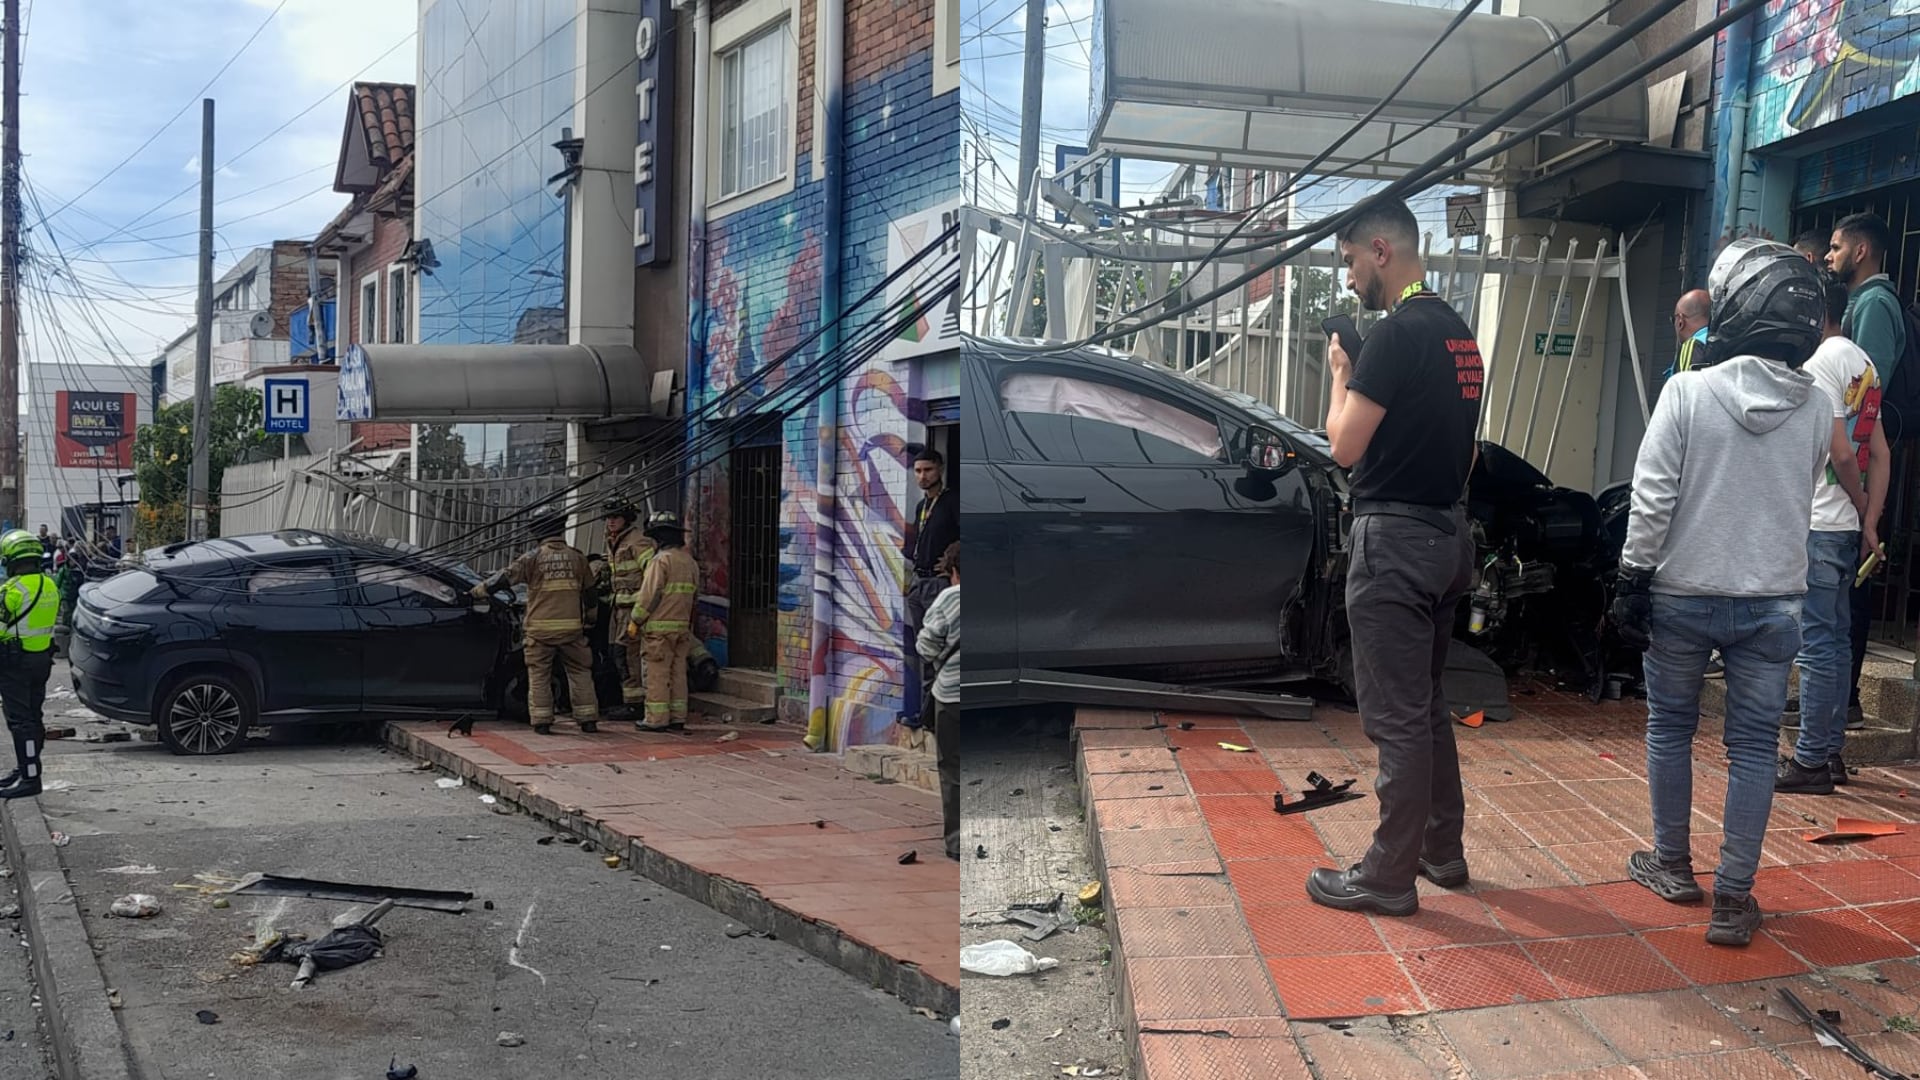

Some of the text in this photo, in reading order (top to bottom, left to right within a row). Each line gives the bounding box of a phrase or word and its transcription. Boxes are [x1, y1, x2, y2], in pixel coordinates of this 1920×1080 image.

[1466, 370, 1483, 383] VALE
[105, 400, 121, 411] ES
[277, 389, 298, 414] H
[270, 419, 304, 429] HOTEL
